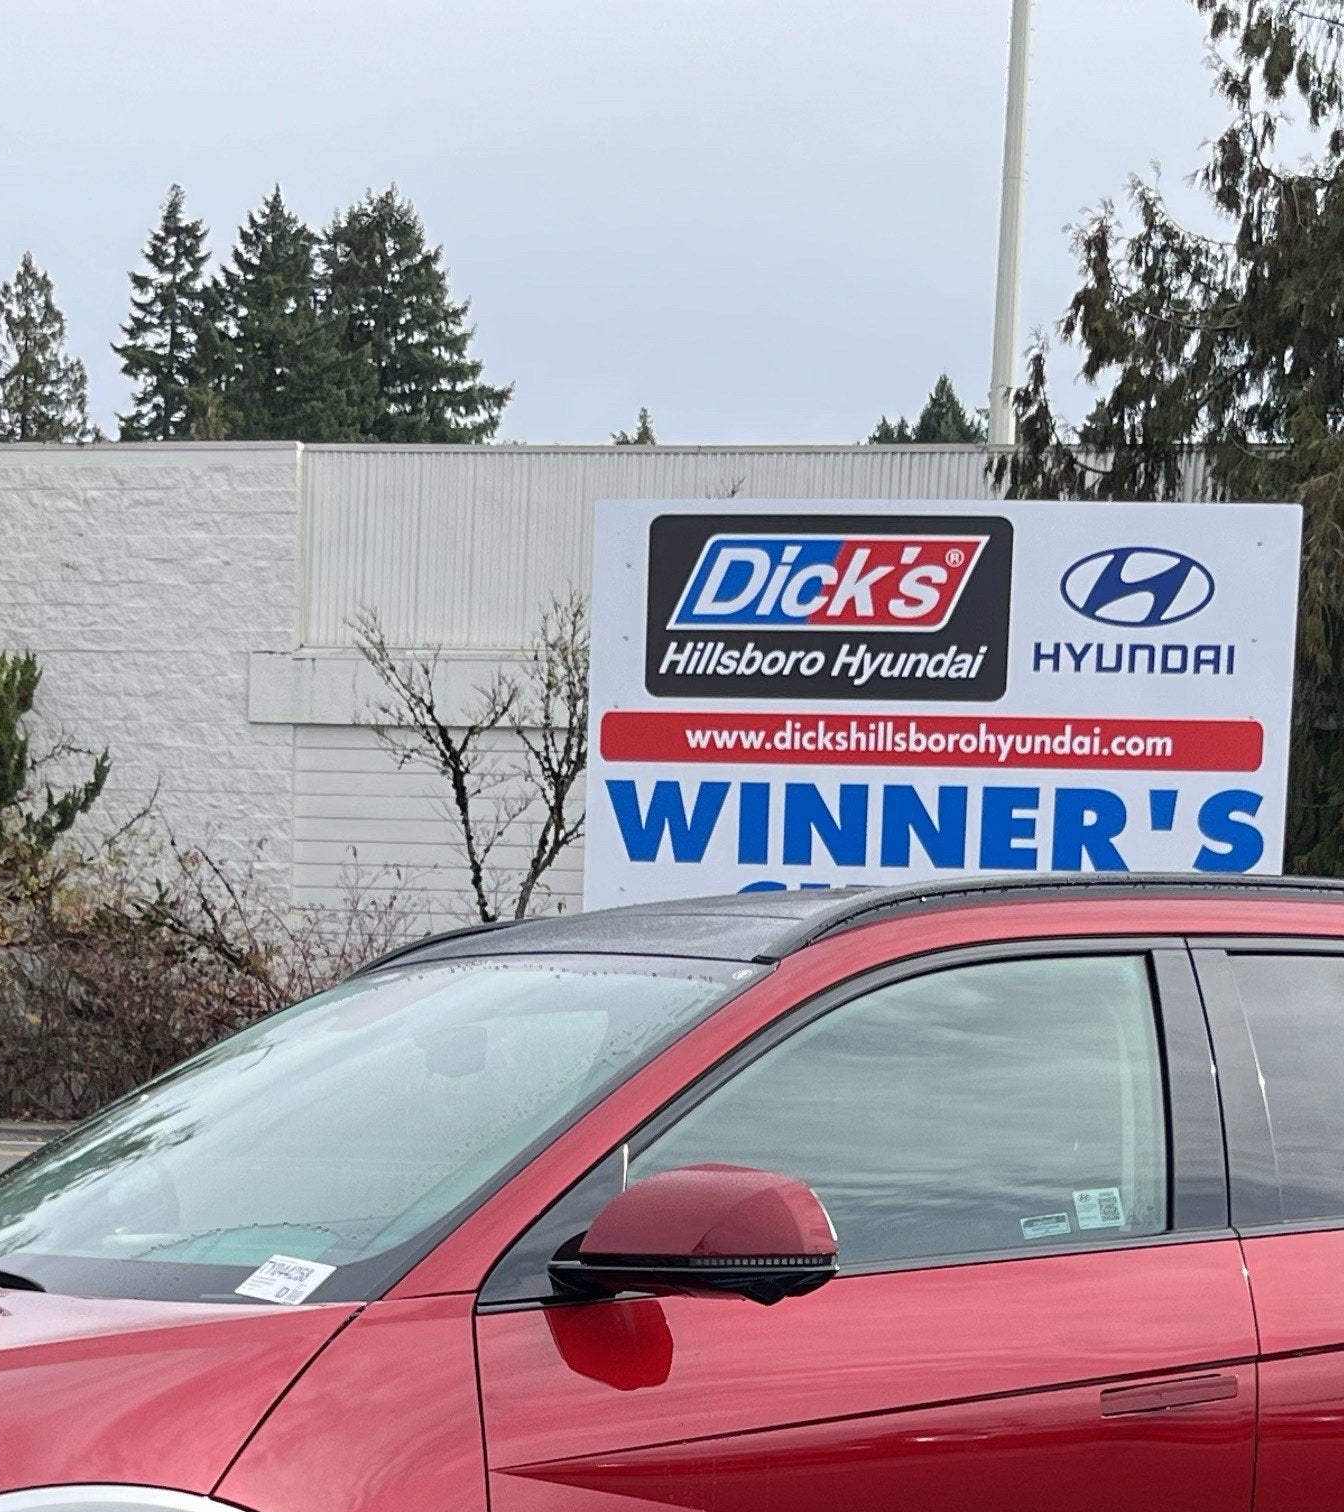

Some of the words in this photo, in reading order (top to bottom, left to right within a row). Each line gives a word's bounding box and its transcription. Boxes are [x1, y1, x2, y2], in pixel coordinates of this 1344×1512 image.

[658, 641, 826, 677] Hillsboro
[830, 643, 989, 686] Hyundai
[1033, 642, 1235, 675] HYUNDAI
[685, 720, 1174, 763] www.dickshillsborohyundai.com
[605, 779, 1265, 874] WINNER'S
